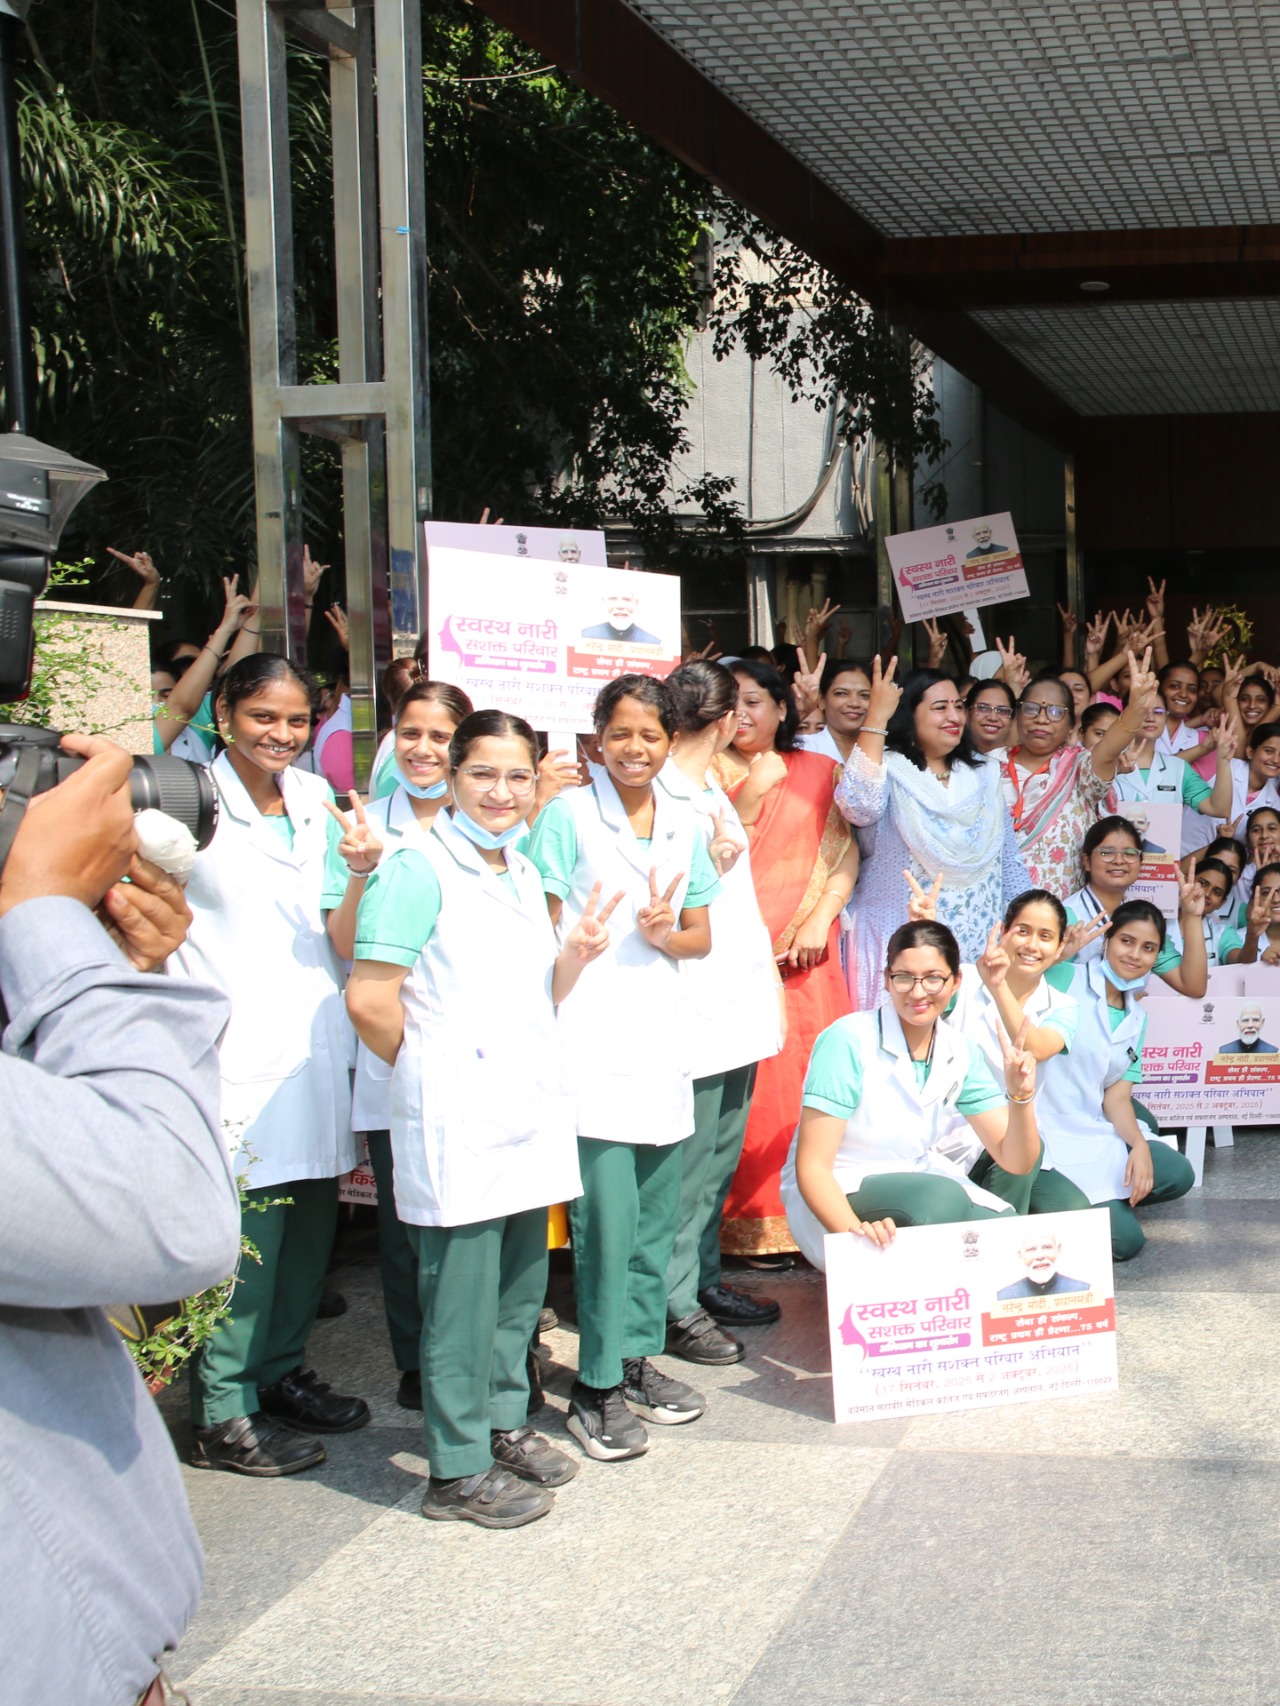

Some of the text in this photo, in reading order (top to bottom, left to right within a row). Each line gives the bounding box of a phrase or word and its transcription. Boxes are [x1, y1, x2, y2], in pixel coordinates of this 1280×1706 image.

[904, 562, 932, 574] स्वस्थ
[934, 554, 956, 567] नारी
[935, 568, 958, 577] परिवार
[455, 616, 559, 640] स्वस्थ नारी
[465, 639, 558, 658] सशक्त परिवार
[1173, 1041, 1203, 1059] नारी
[1168, 1059, 1201, 1071] परिवार
[1154, 1088, 1171, 1099] नारी
[1173, 1090, 1201, 1099] सशक्त
[1203, 1088, 1229, 1098] परिवार
[856, 1287, 971, 1321] स्वस्थ नारी
[868, 1315, 972, 1339] सशक्त परिवार
[907, 1359, 933, 1374] नारी
[937, 1357, 980, 1371] सशक्त
[984, 1350, 1023, 1366] परिवार
